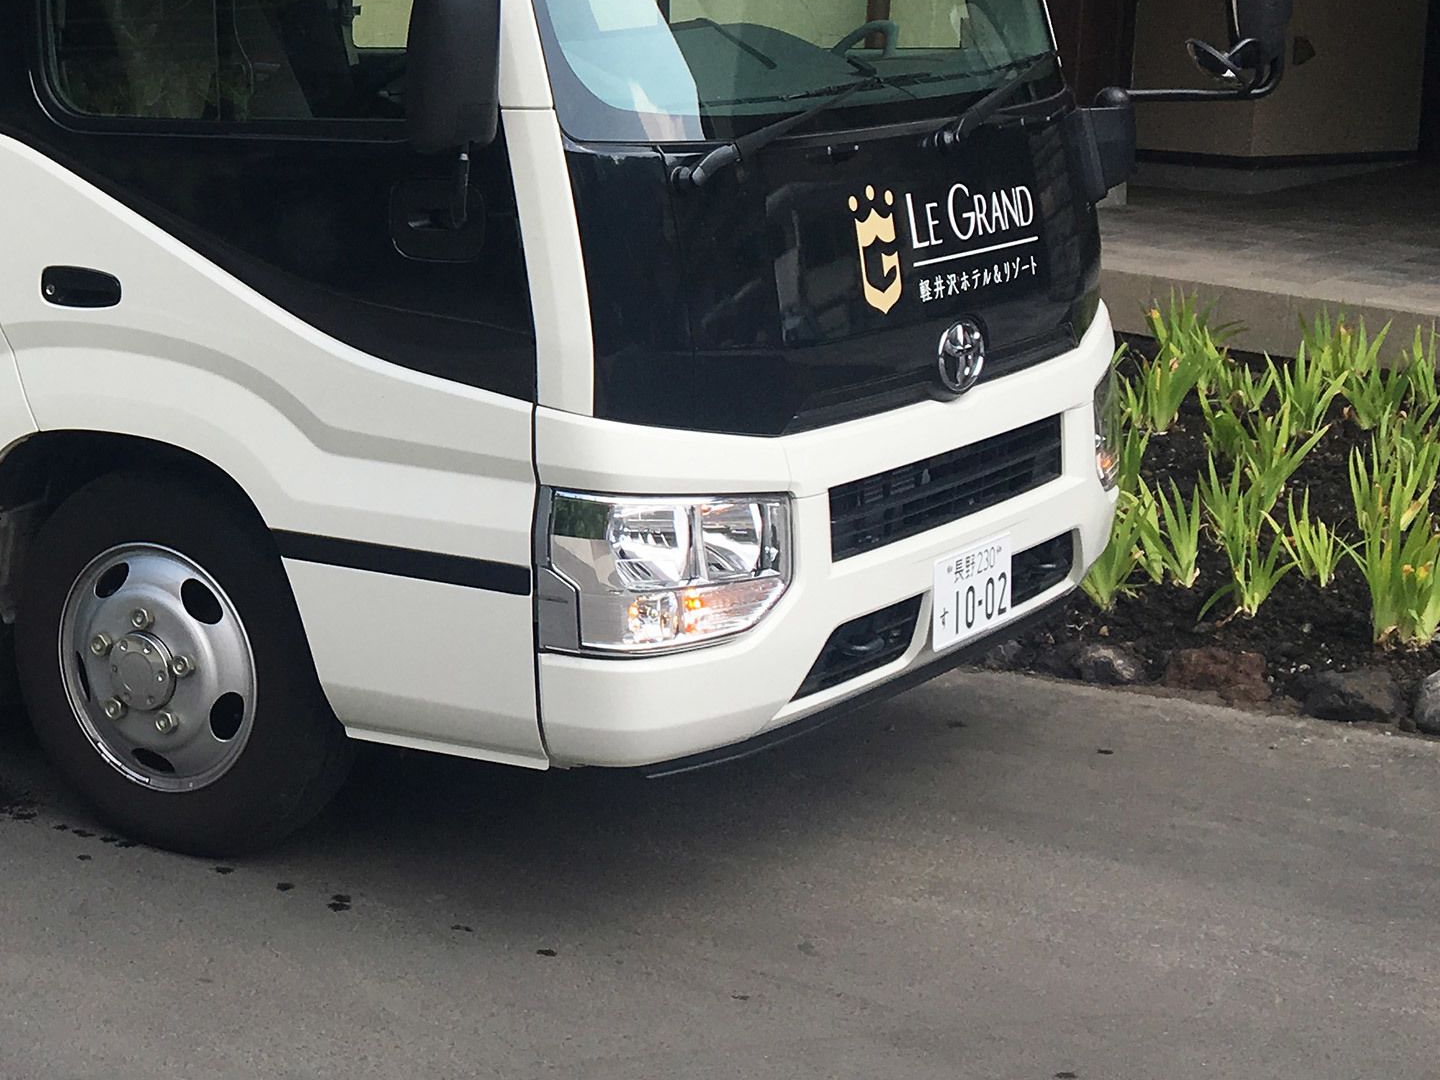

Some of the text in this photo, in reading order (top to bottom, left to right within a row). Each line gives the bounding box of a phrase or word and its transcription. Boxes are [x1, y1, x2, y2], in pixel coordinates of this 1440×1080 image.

[905, 183, 1034, 249] LE GRAND
[955, 571, 1007, 635] 10-02
